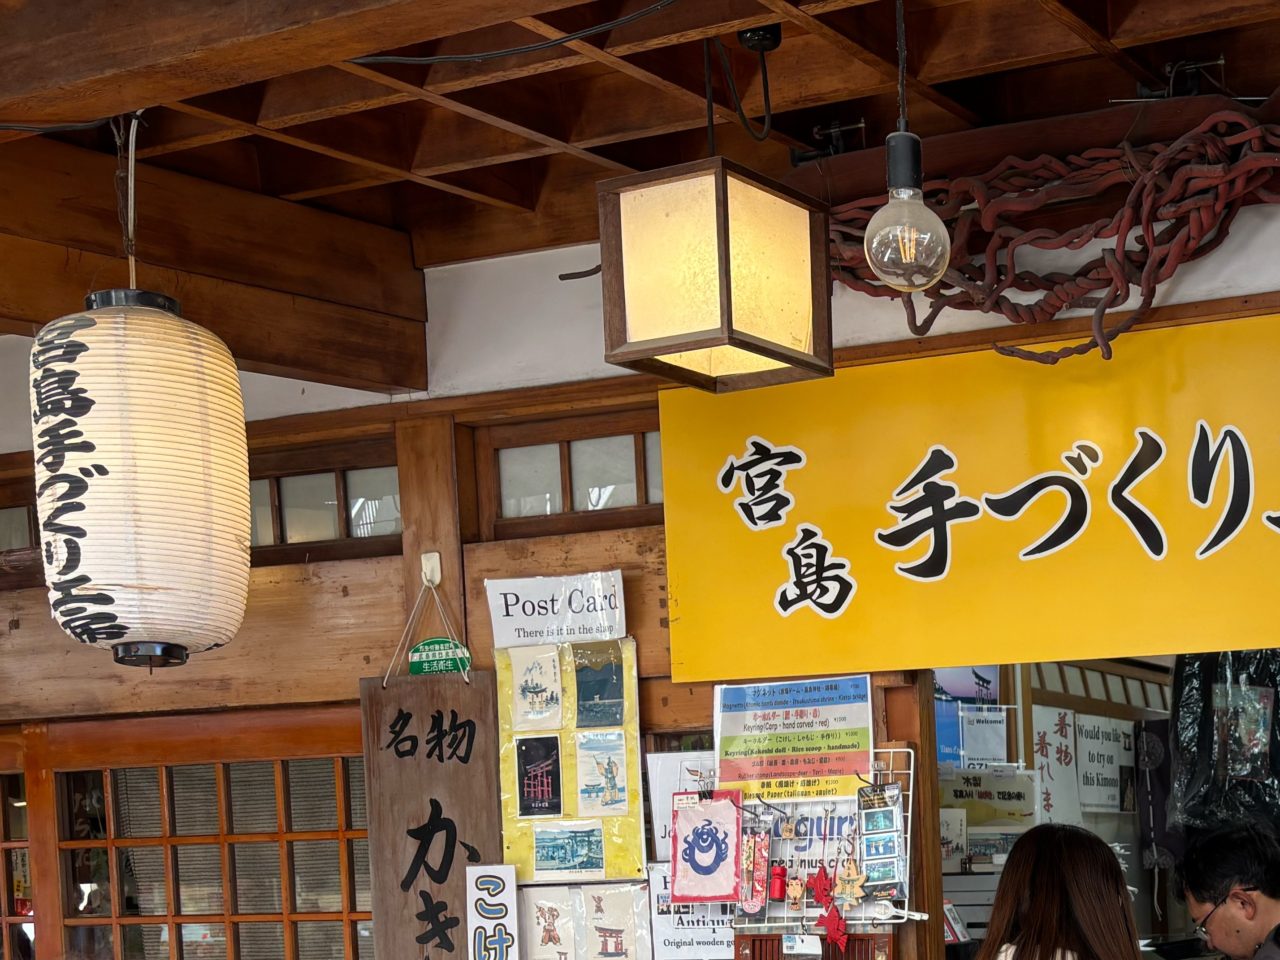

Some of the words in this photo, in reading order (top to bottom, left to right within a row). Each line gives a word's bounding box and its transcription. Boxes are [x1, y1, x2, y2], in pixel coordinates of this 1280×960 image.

[716, 436, 859, 619] 宮島
[499, 591, 560, 618] Post
[567, 584, 619, 615] Card
[514, 627, 545, 638] There
[546, 626, 555, 636] is
[556, 626, 564, 636] it
[566, 625, 576, 636] in
[578, 624, 594, 635] the
[384, 707, 477, 764] 名物
[1077, 723, 1100, 741] Would
[1101, 730, 1111, 745] you
[1088, 750, 1096, 763] to
[1096, 751, 1106, 768] try
[1107, 754, 1114, 765] on
[1082, 771, 1095, 787] this
[1096, 772, 1119, 788] Kimono
[663, 938, 694, 949] Original
[696, 938, 725, 946] wooden
